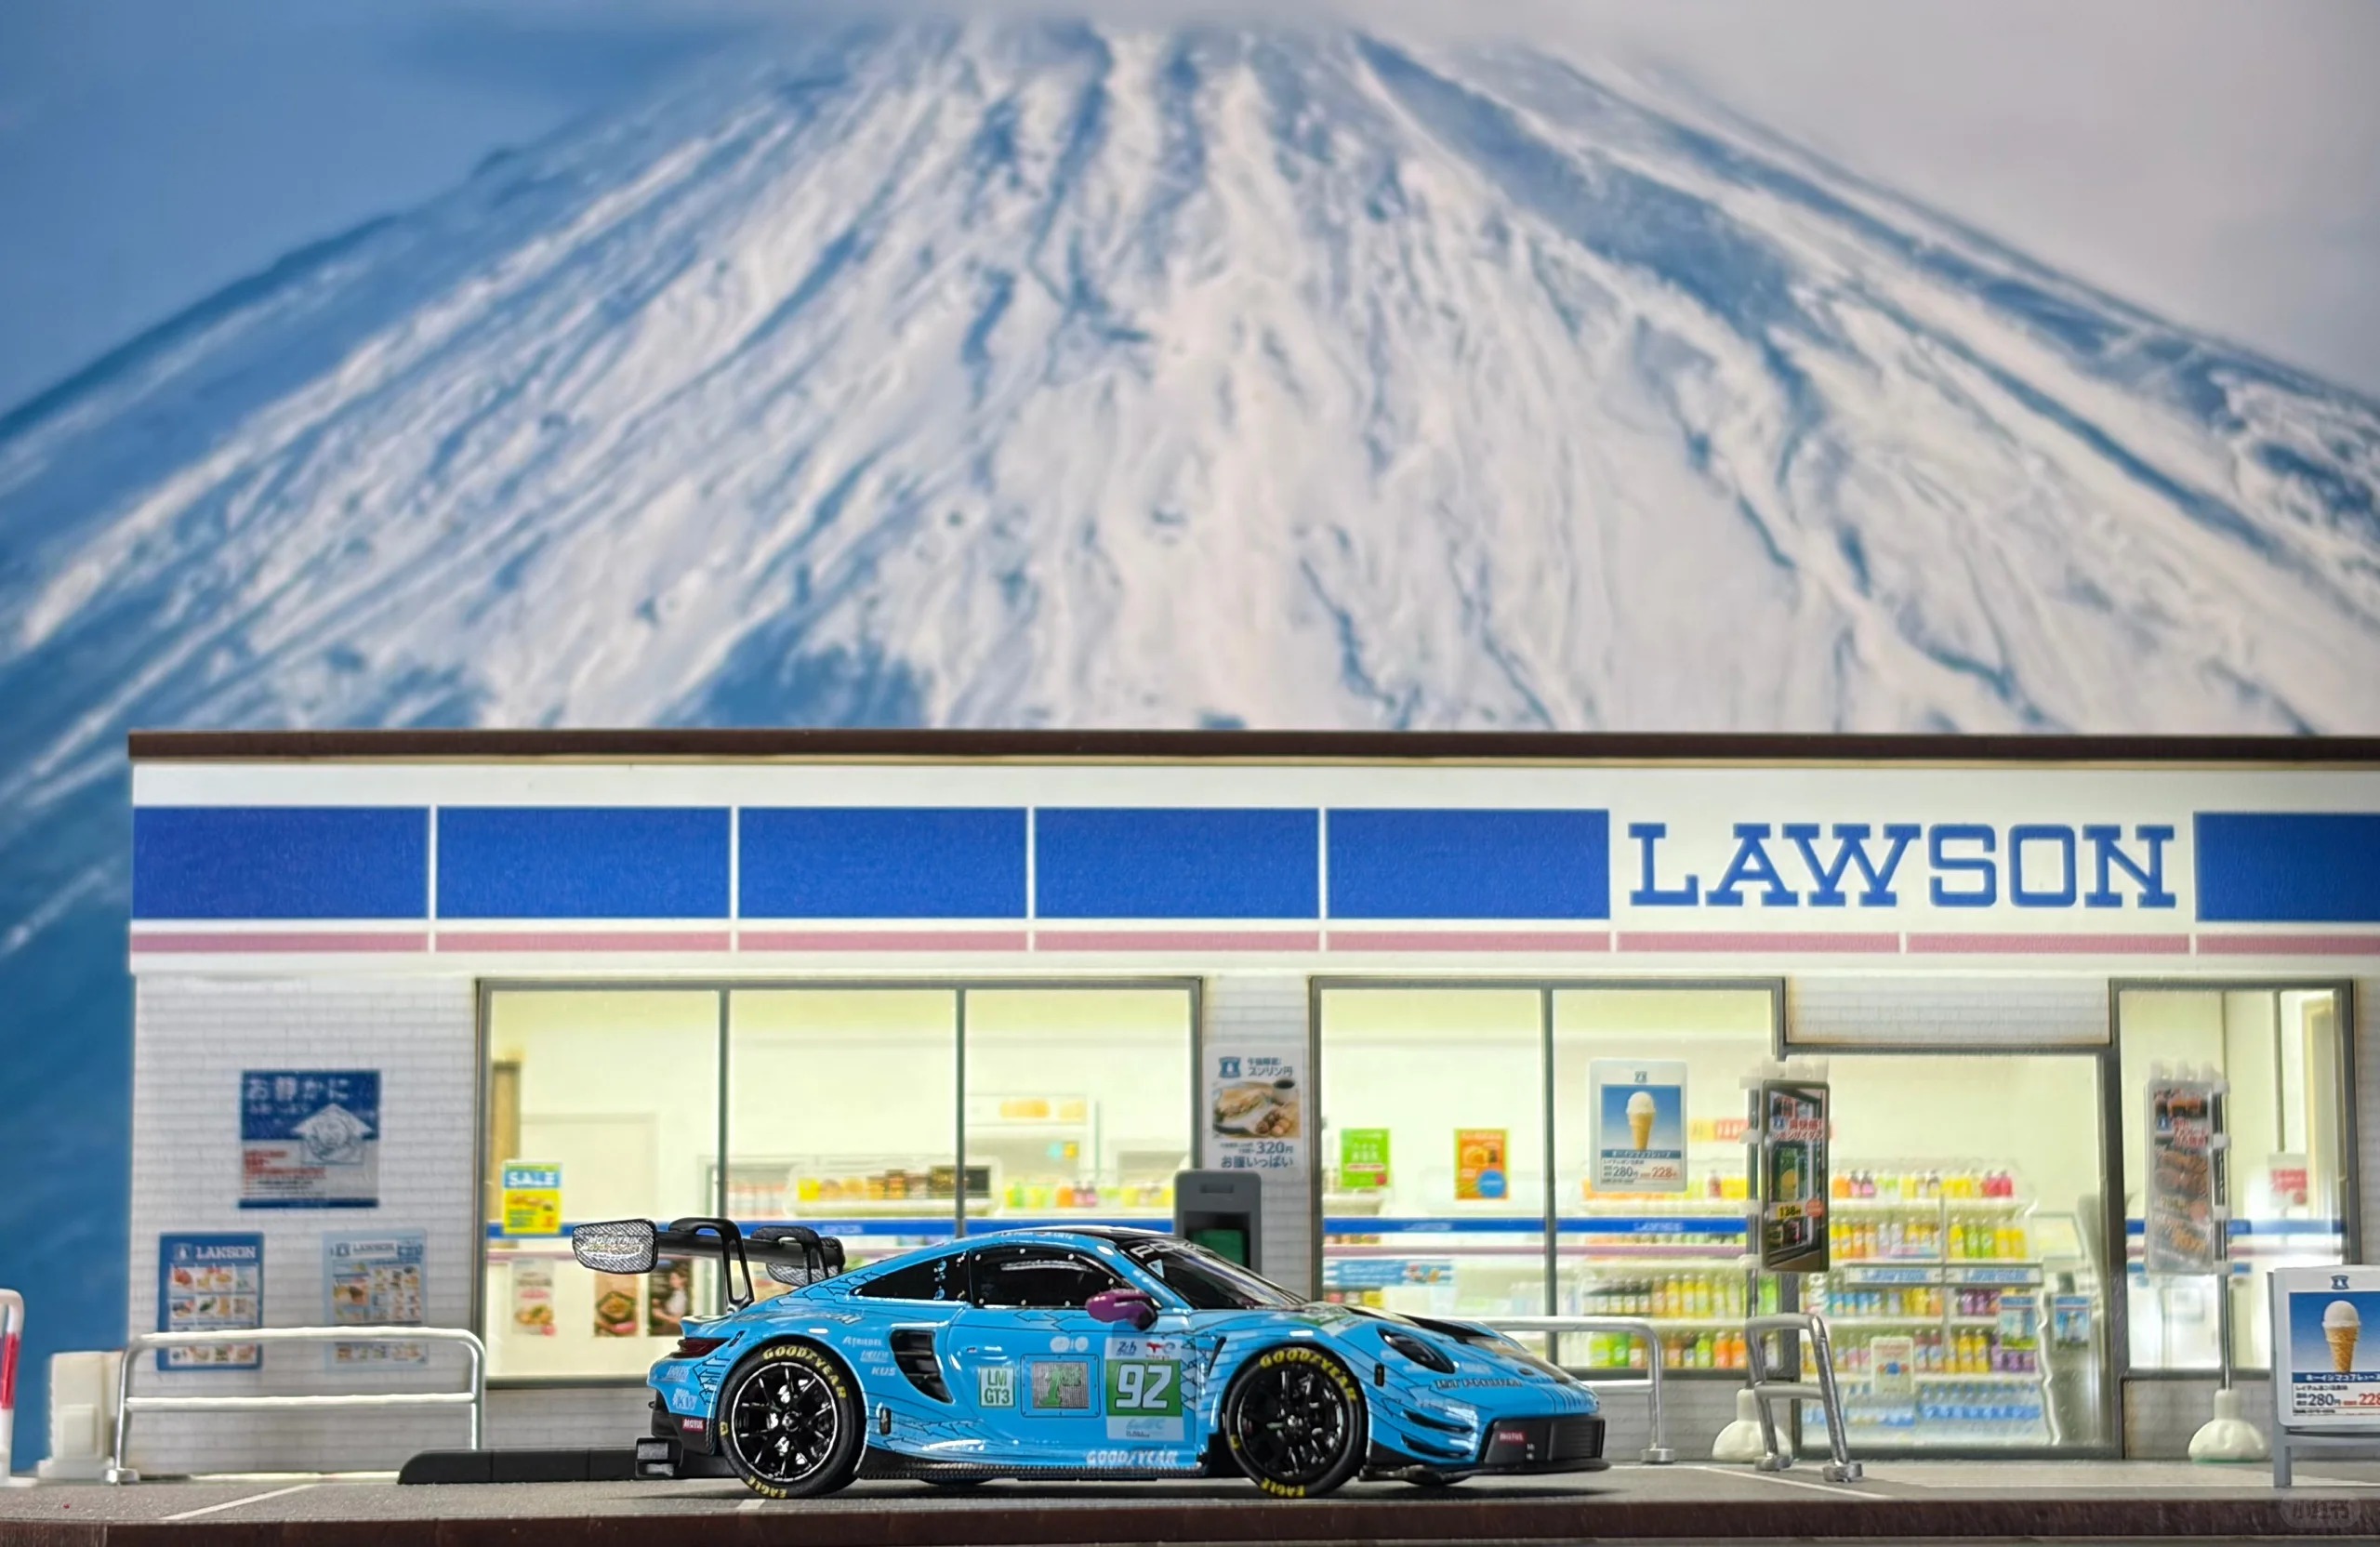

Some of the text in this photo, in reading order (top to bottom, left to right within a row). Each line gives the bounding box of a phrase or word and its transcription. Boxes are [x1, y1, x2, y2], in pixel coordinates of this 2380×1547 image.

[1629, 823, 2176, 908] LAWSON
[508, 1170, 556, 1186] SALE
[762, 1345, 847, 1398] GOODYEAR
[986, 1368, 1008, 1387] LM
[1115, 1363, 1172, 1409] 92
[1260, 1349, 1357, 1402] GOODYEAR
[984, 1388, 1011, 1405] GT3
[746, 1474, 787, 1500] EAGLE
